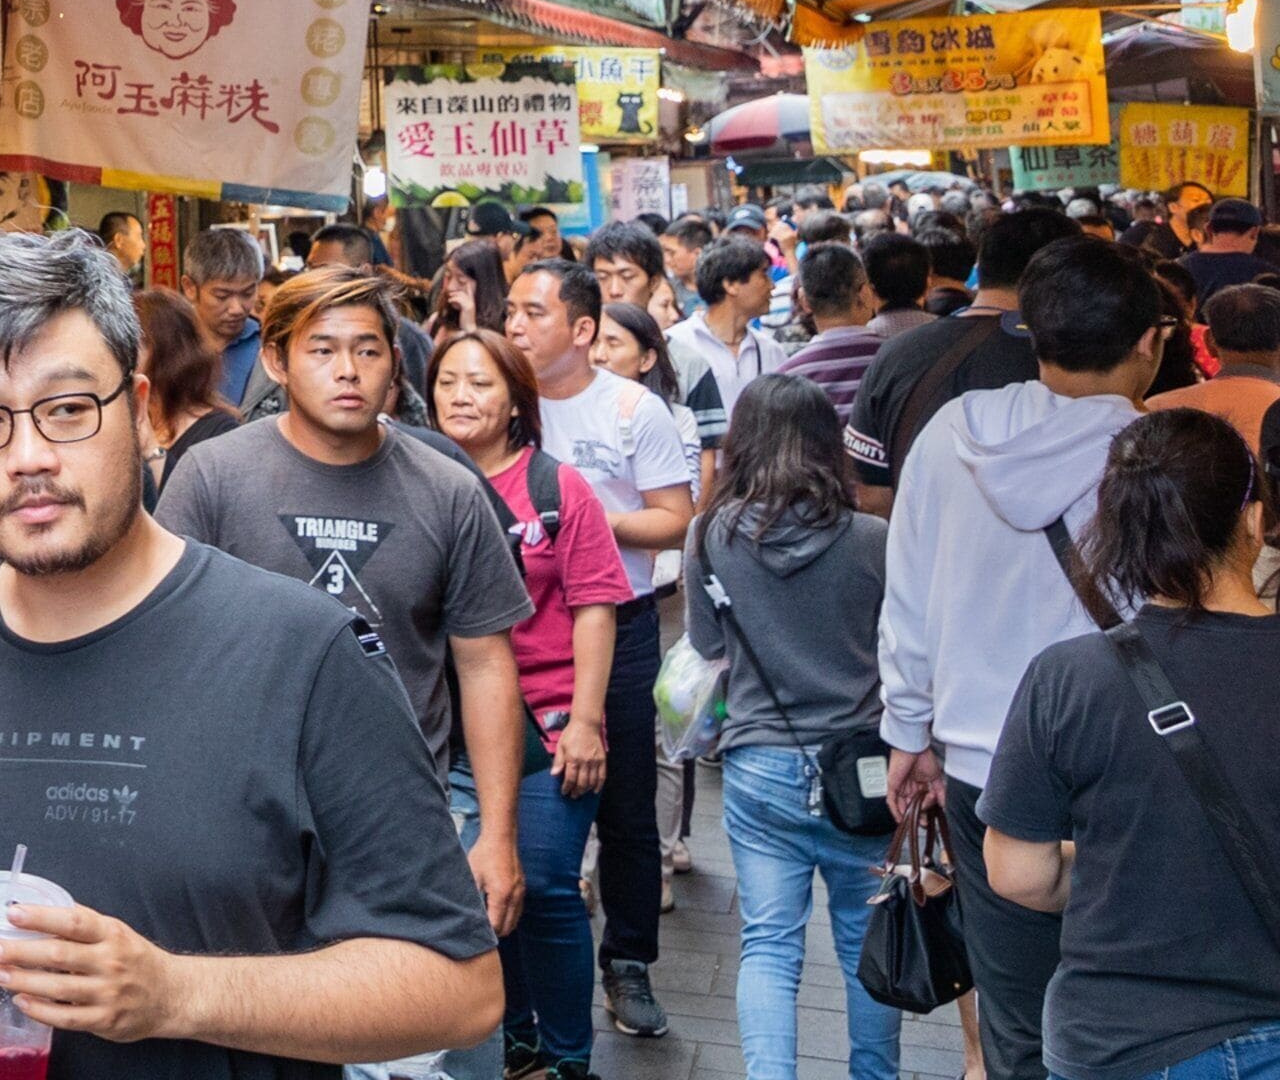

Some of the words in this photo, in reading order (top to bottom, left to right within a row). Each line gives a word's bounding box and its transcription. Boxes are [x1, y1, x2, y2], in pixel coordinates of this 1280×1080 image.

[396, 93, 572, 116] 來自深山的禮物
[439, 161, 529, 178] 飲品專賣店
[295, 516, 378, 542] TRIANGLE
[327, 563, 345, 595] 3
[46, 783, 109, 802] adidas
[44, 805, 79, 821] ADV
[91, 808, 136, 825] 91-17
